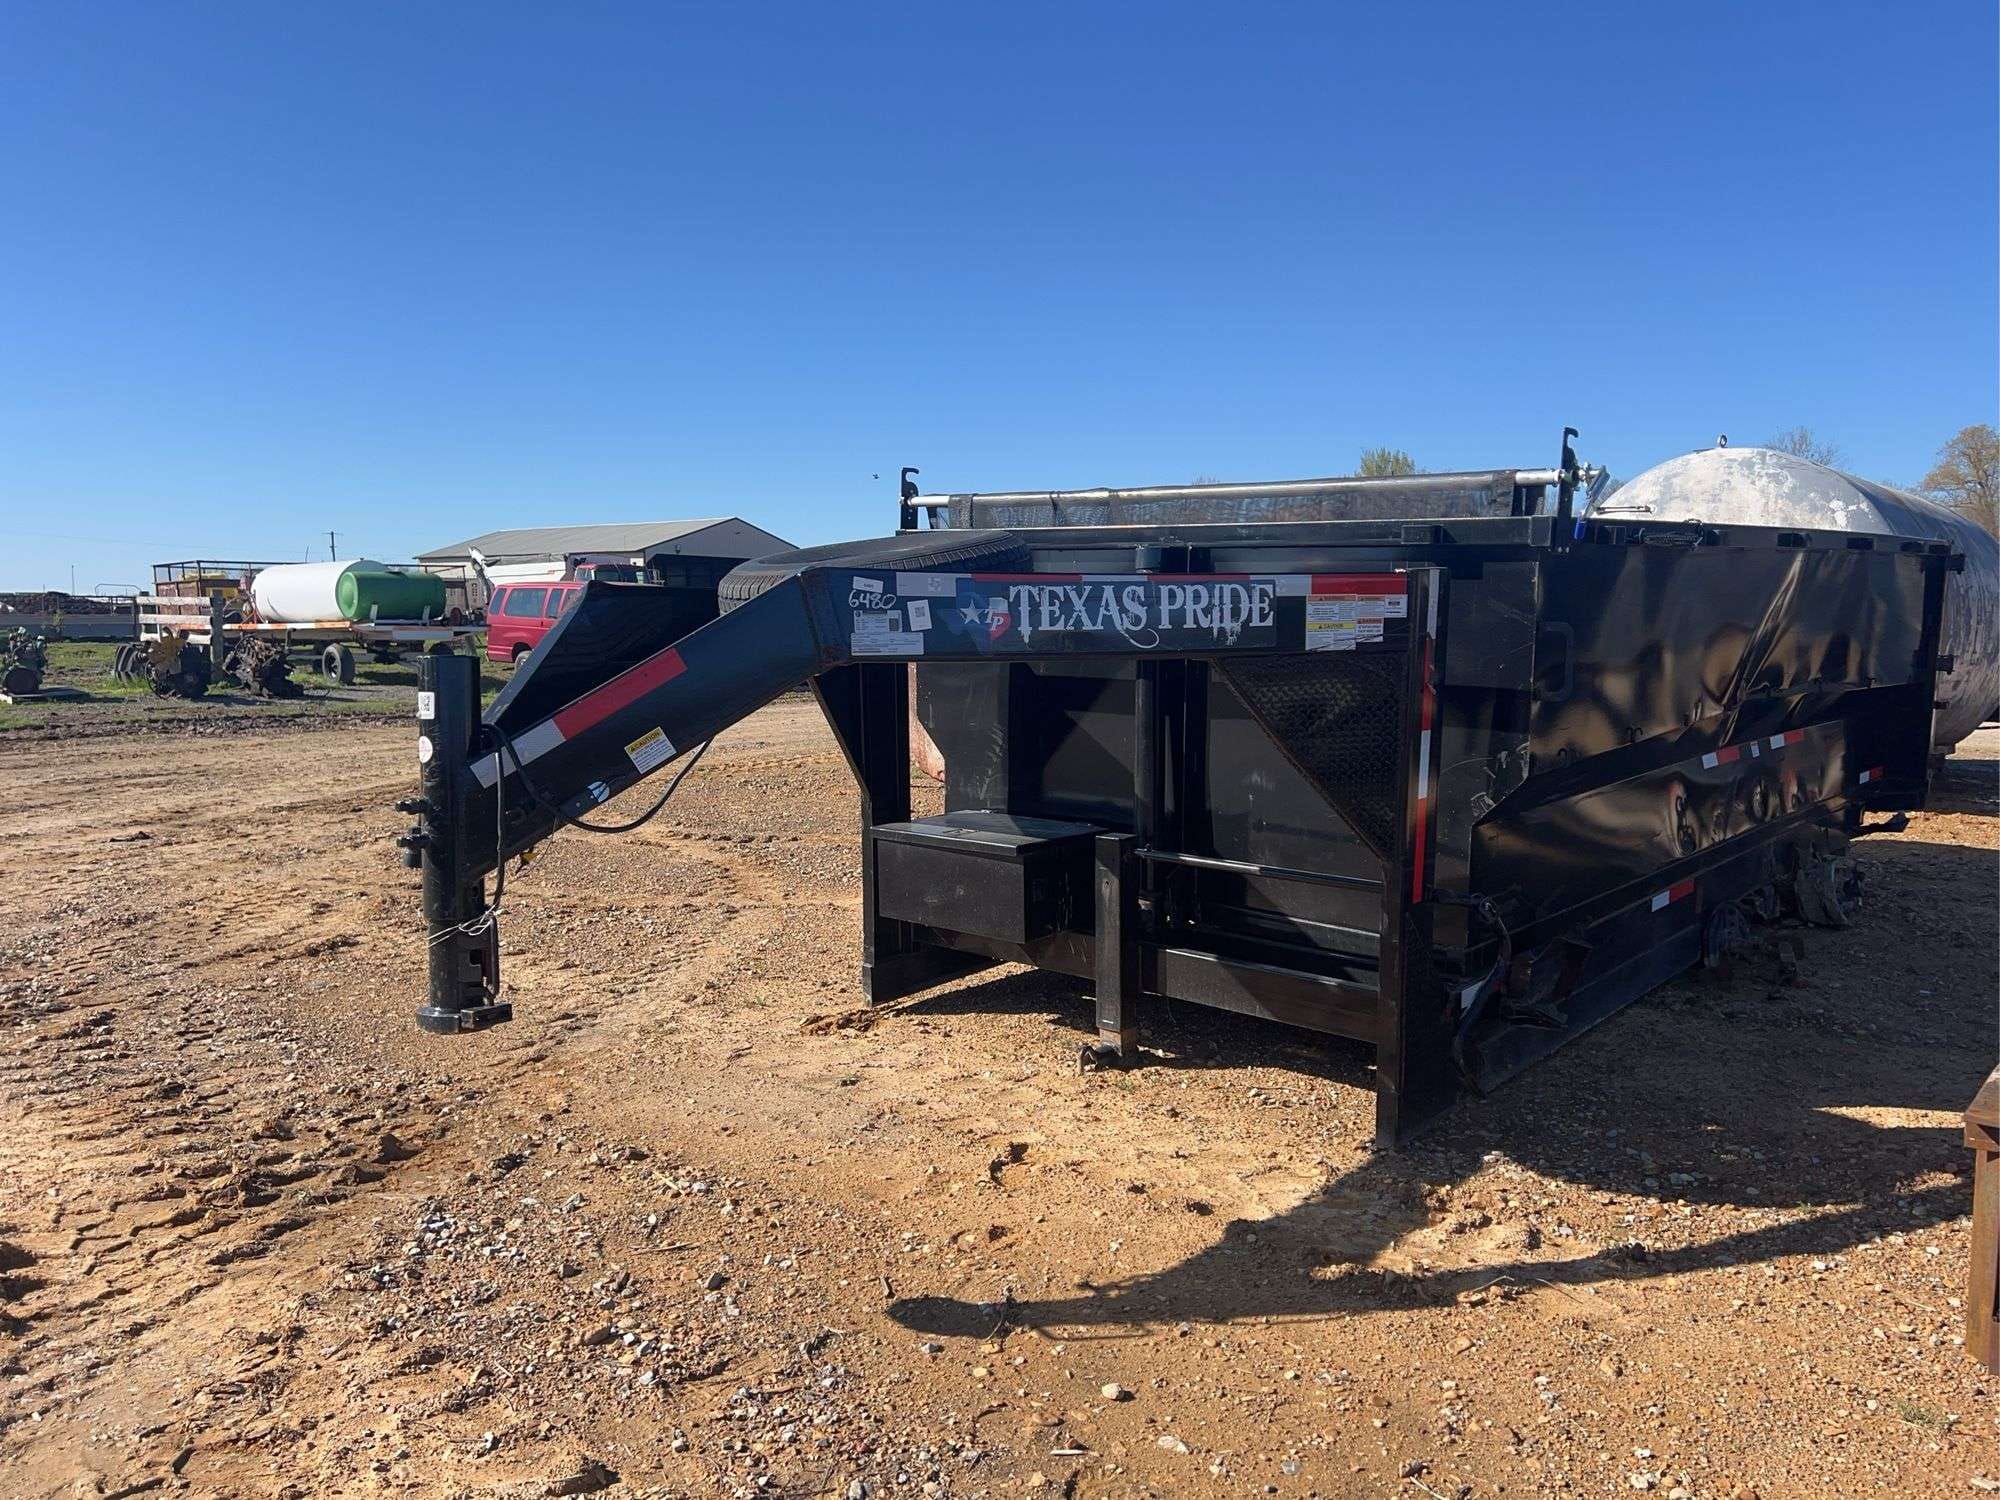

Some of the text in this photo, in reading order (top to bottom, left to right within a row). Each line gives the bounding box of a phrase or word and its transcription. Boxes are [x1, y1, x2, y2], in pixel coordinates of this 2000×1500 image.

[848, 590, 897, 610] 6480
[1009, 584, 1159, 648] TEXAS
[1158, 584, 1275, 647] PRIDE
